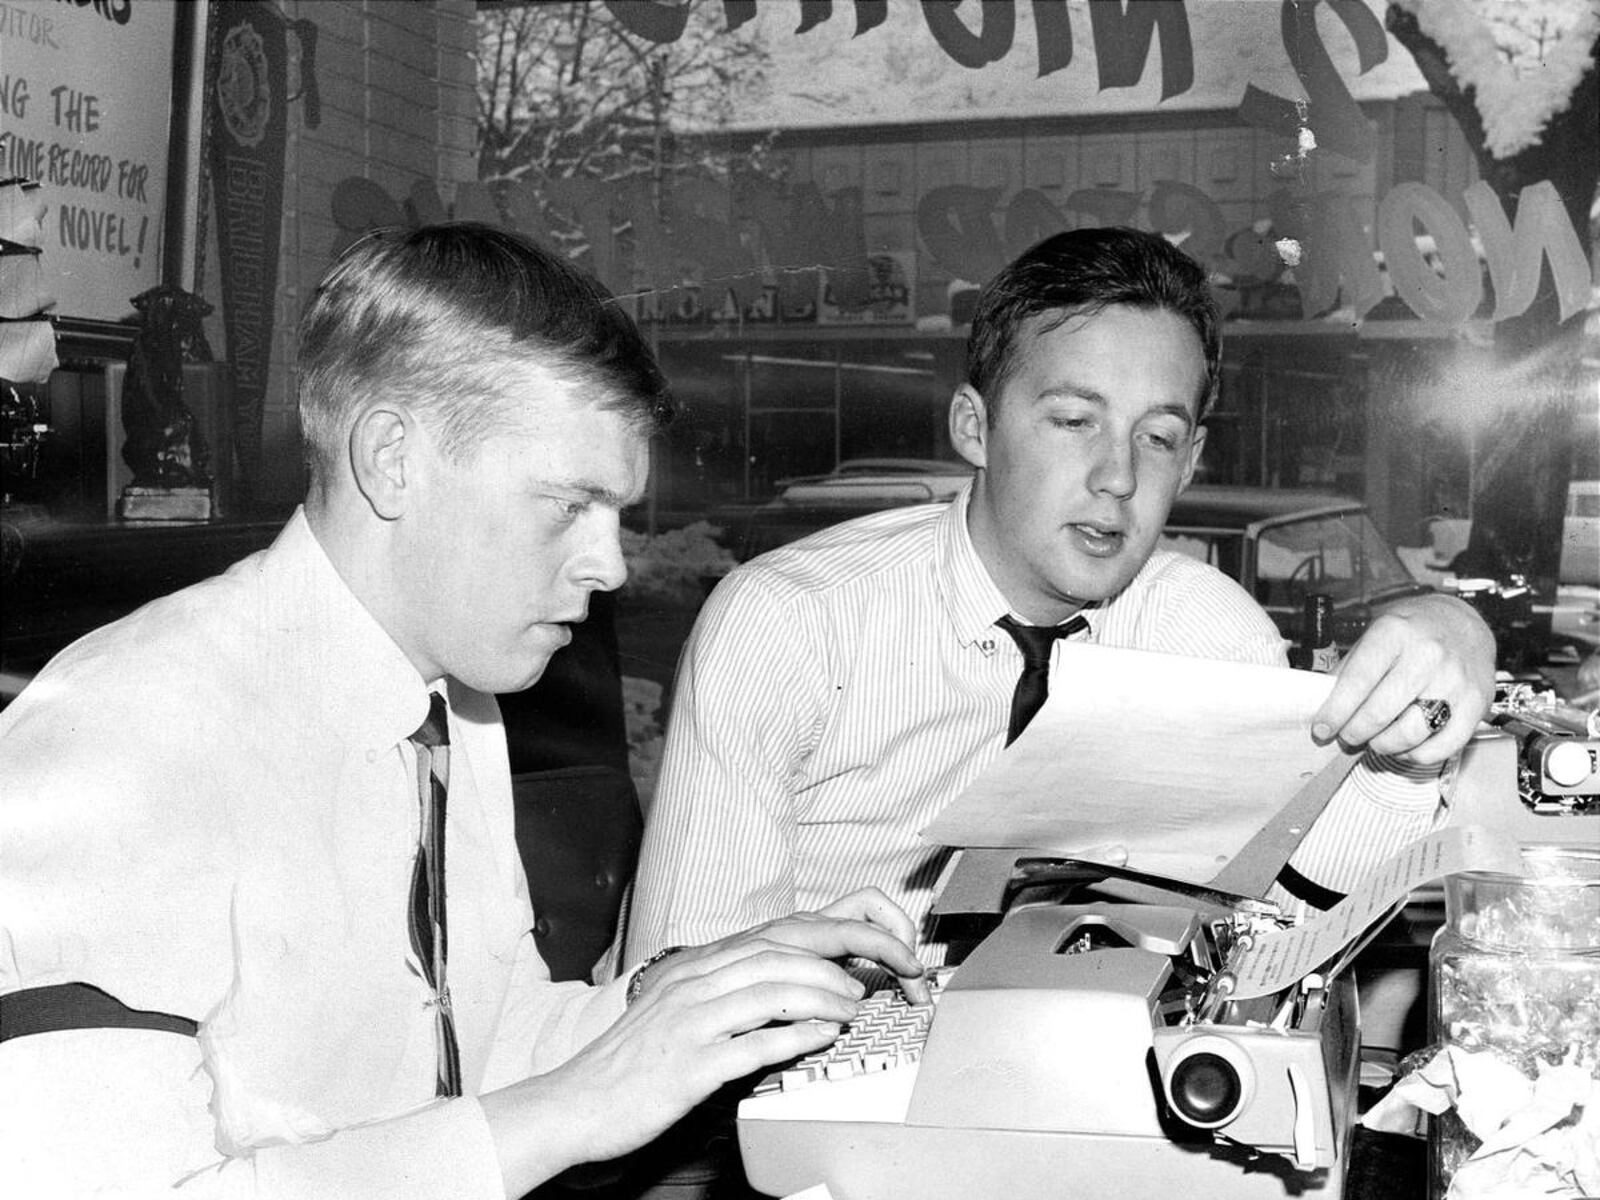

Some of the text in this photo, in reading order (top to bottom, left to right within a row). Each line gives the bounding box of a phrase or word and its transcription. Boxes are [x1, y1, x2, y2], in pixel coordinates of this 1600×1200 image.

[51, 85, 99, 133] THE
[49, 143, 112, 193] RECORD
[118, 160, 148, 203] FOR
[60, 204, 148, 269] NOVEL!
[225, 155, 268, 390] BRIGHAM
